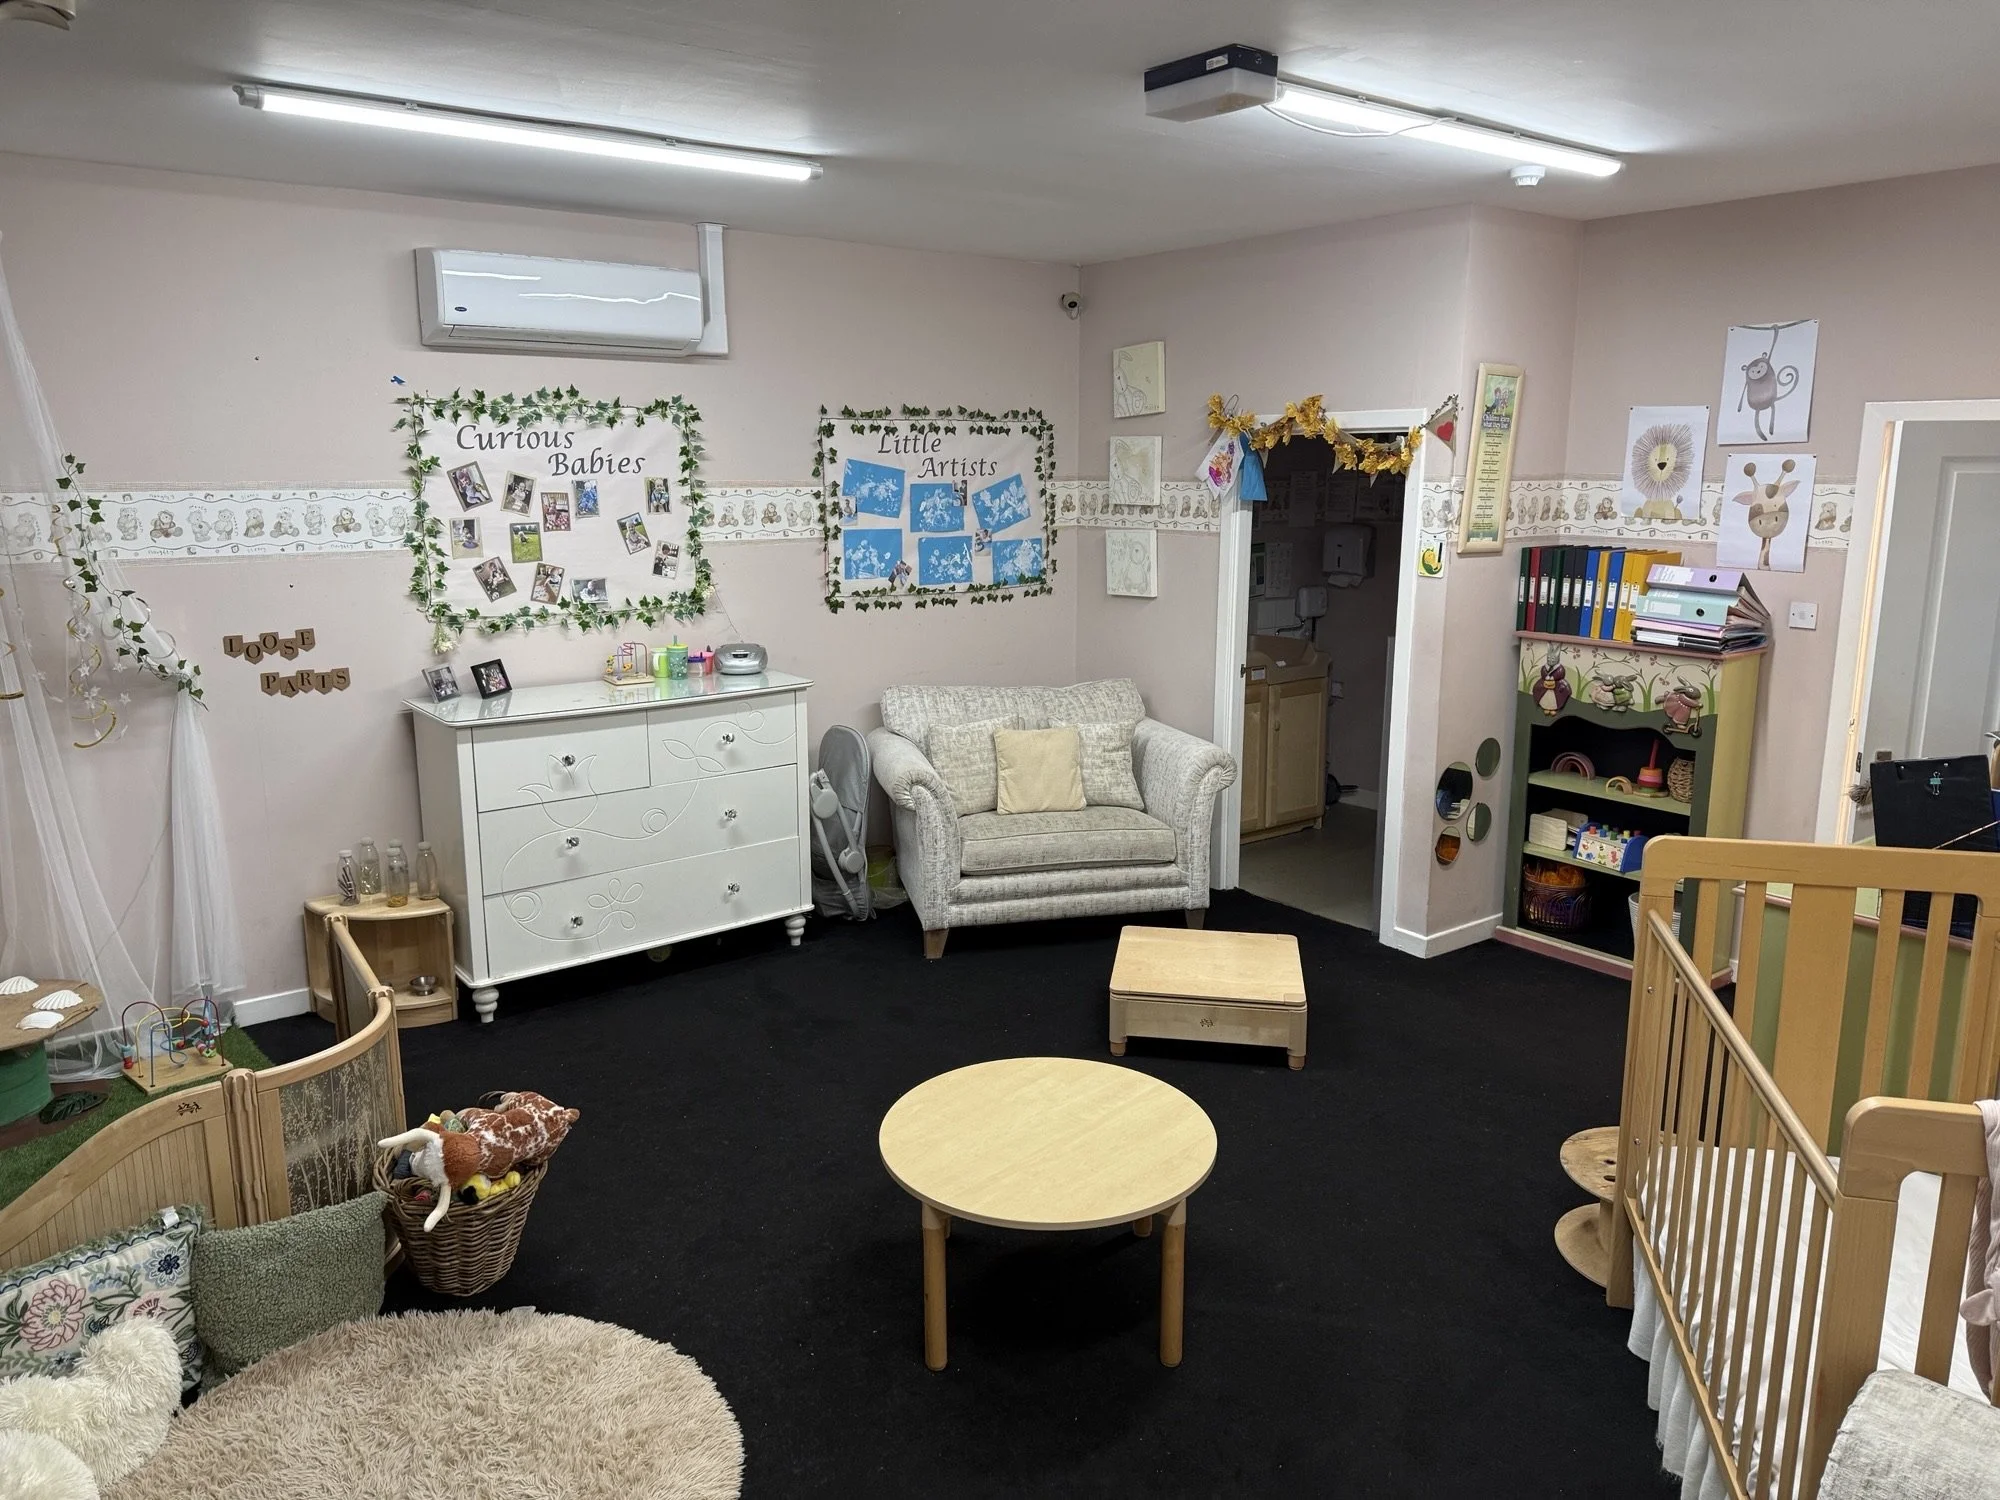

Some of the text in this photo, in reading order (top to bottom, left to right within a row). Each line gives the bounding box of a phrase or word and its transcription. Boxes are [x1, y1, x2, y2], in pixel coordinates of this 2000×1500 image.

[456, 424, 575, 450] Curious
[878, 430, 942, 454] Little
[548, 447, 646, 476] Babies
[917, 457, 998, 479] Artists
[228, 631, 314, 659] LOOSE
[265, 670, 347, 693] PARTS
